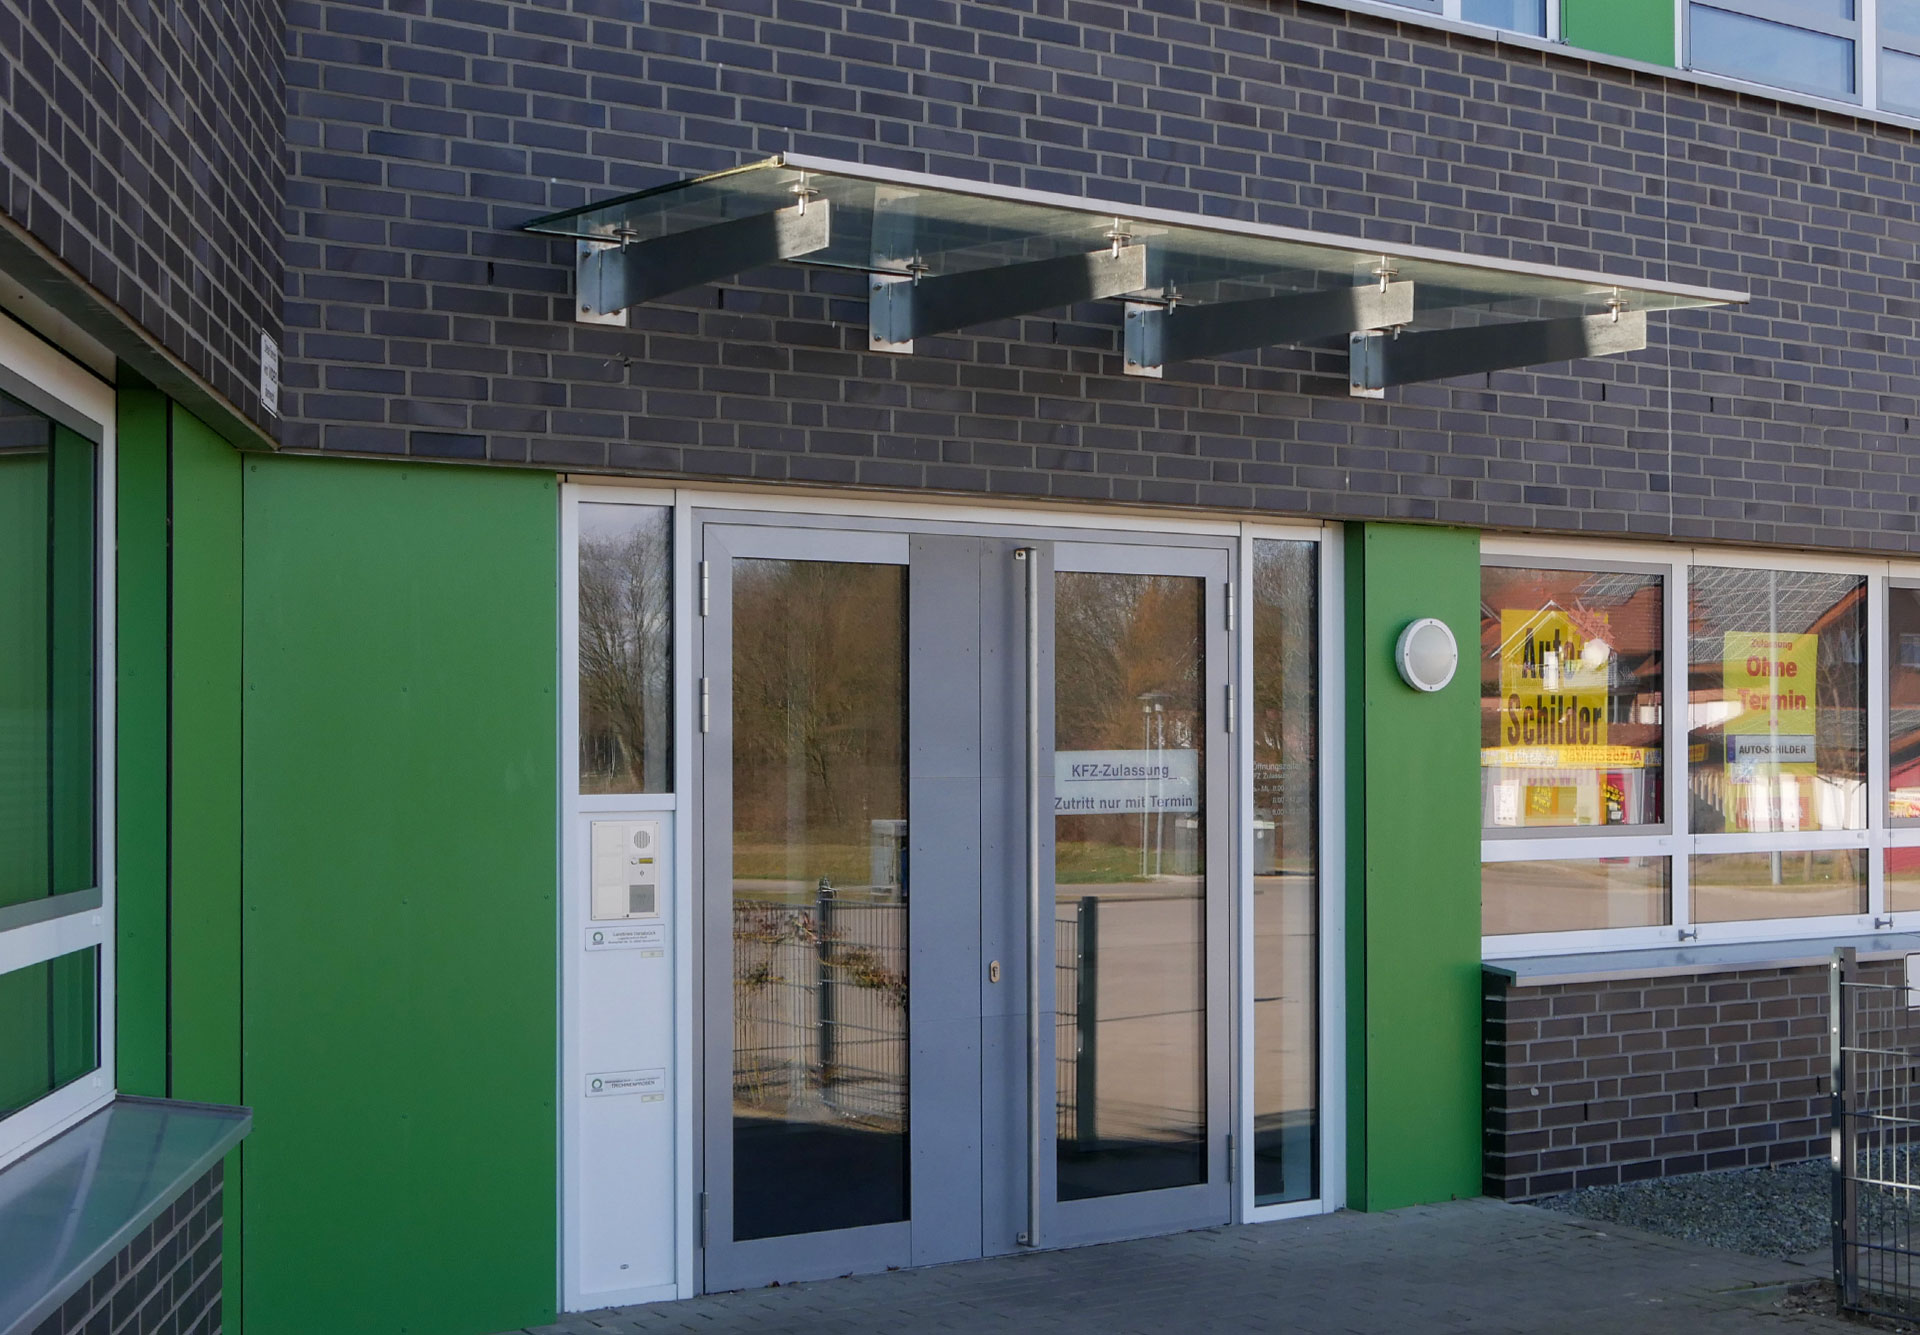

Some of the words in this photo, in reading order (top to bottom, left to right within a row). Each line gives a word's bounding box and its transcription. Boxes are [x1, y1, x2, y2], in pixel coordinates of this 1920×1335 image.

[1751, 638, 1793, 651] Zulaung
[1746, 655, 1798, 678] Ohne
[1737, 688, 1807, 711] Termin
[1507, 693, 1602, 745] Schilder
[1739, 745, 1807, 755] AUTO-SCHILDER
[1071, 763, 1169, 779] KFZ-Zulassung
[1054, 797, 1095, 810] Zutritt
[1099, 798, 1121, 809] nur
[1125, 796, 1146, 808] mit
[1149, 794, 1194, 809] Termin
